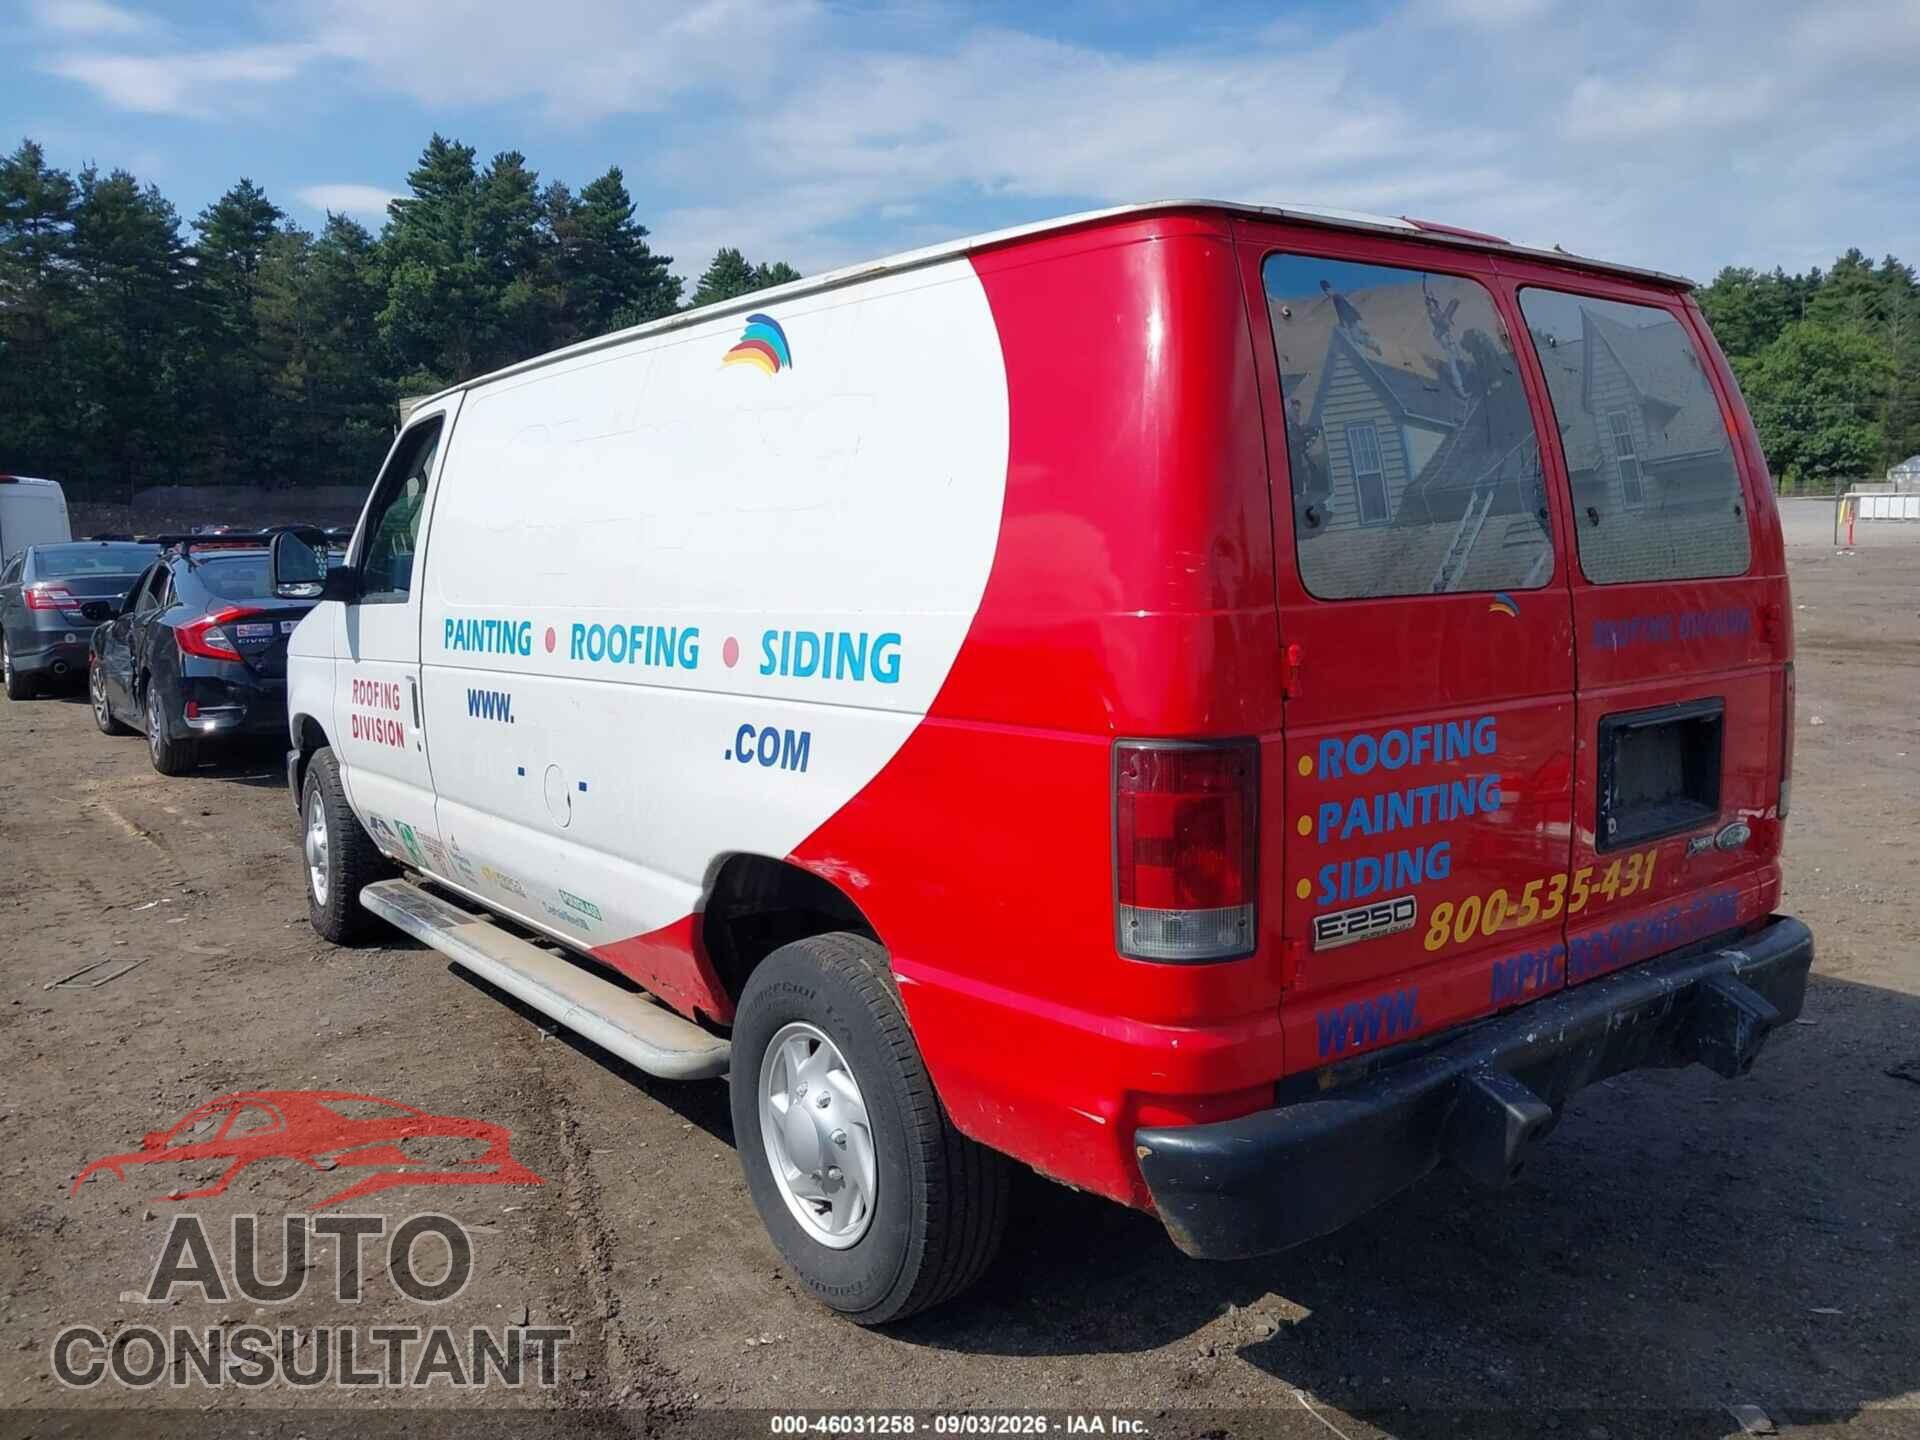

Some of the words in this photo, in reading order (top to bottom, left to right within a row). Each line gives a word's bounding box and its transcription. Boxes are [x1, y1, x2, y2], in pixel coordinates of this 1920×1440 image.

[444, 618, 533, 656] PAINTING
[570, 623, 700, 670] ROOFING
[758, 629, 903, 684] SIDING
[351, 679, 401, 711] ROOFING
[467, 688, 515, 724] WWW.
[351, 713, 405, 749] DIVISION
[724, 723, 812, 774] .COM
[1317, 716, 1499, 781] ROOFING
[1317, 774, 1502, 844] PAINTING
[1317, 842, 1452, 906] SIDING
[1423, 848, 1658, 951] 800-535-431
